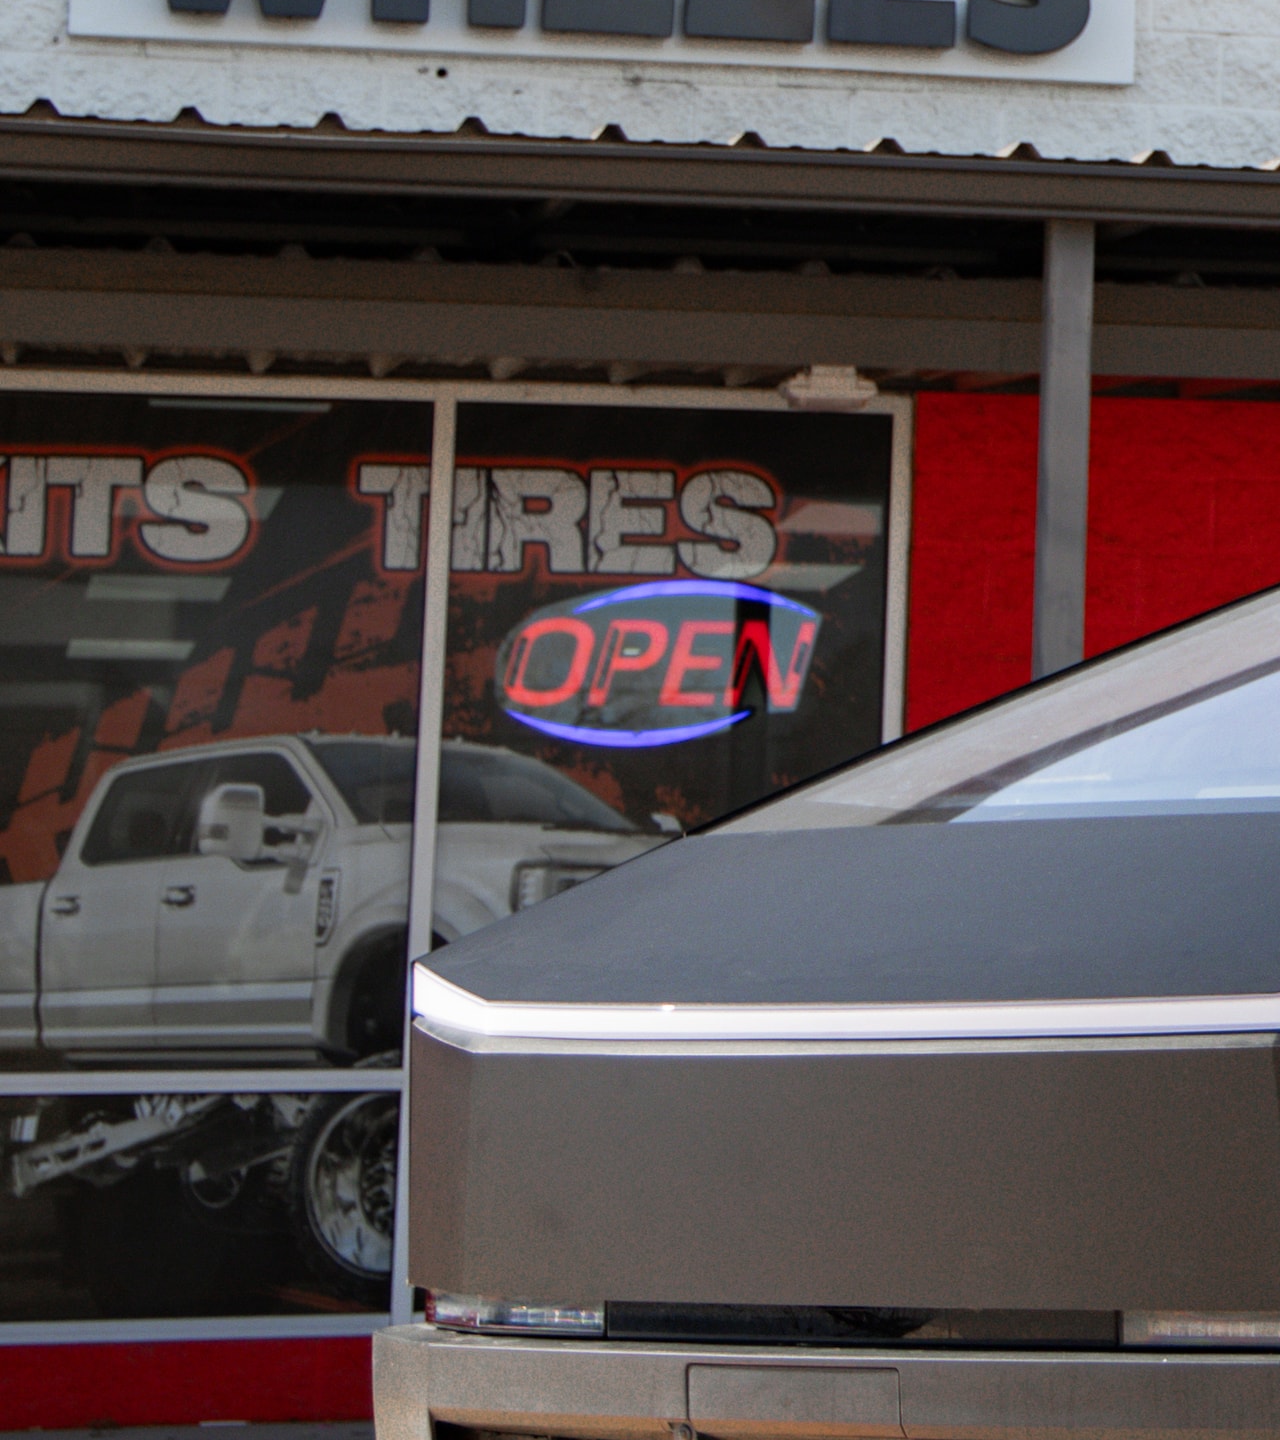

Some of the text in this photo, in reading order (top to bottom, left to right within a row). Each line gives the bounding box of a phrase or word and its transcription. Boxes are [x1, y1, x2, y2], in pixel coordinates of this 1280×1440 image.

[0, 456, 249, 563] ITS
[359, 464, 777, 579] TIRES
[505, 617, 816, 708] OPEN
